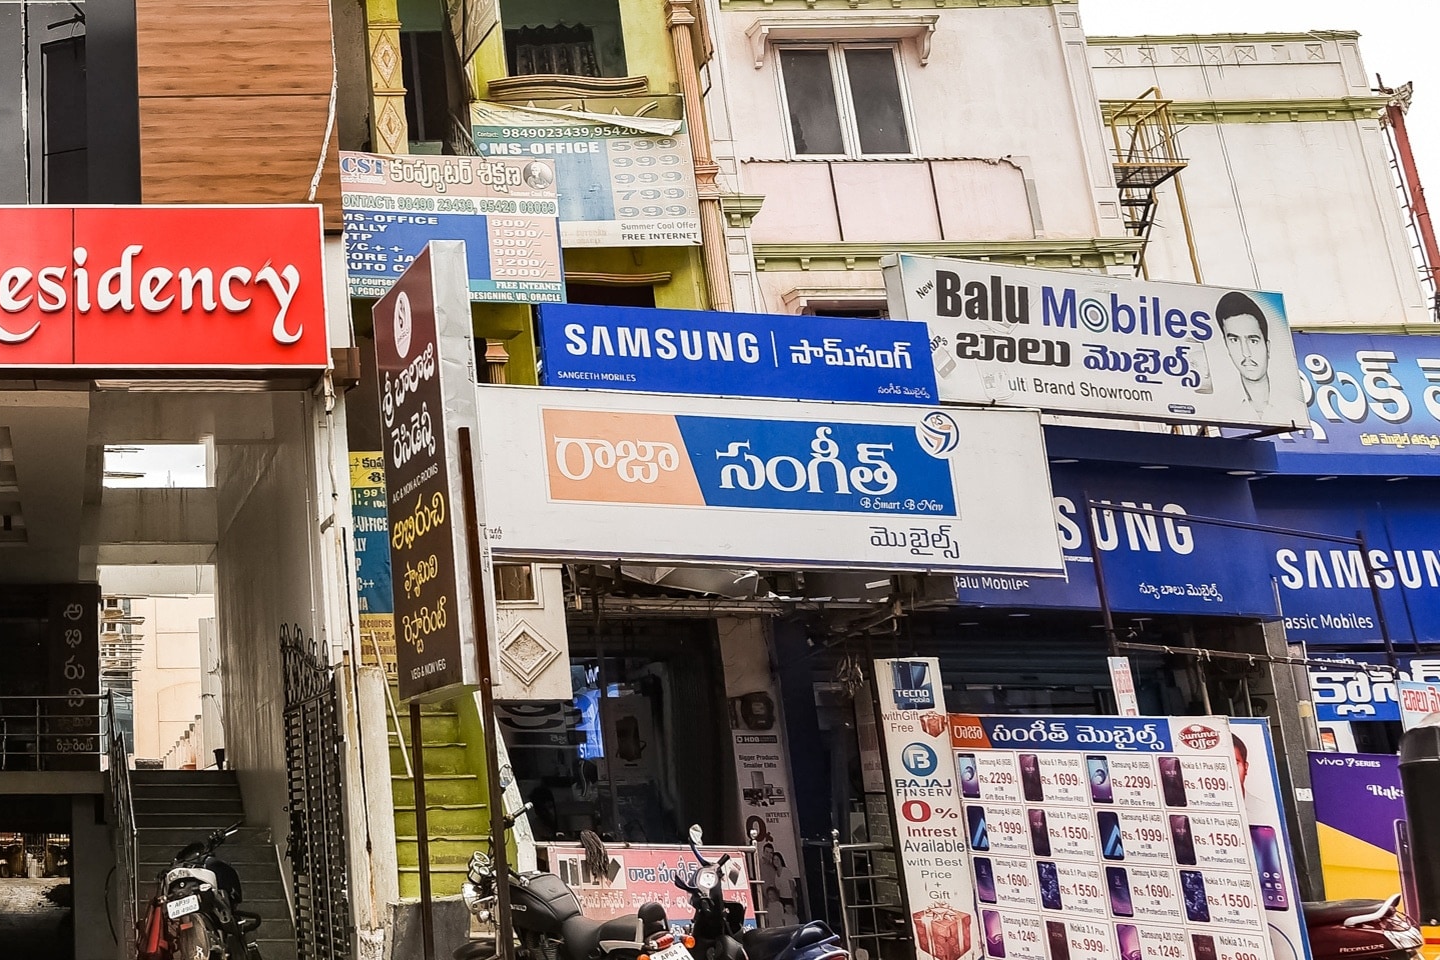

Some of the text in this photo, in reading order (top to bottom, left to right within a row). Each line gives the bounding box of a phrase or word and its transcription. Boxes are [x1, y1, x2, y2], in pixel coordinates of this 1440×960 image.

[490, 142, 599, 154] MS-OFFICE
[342, 157, 386, 175] CST
[389, 158, 473, 194] కంప్యూటర్
[397, 196, 557, 215] 98490 23439, 95420 08089
[677, 221, 697, 229] Offer
[493, 229, 552, 238] 1500/-
[494, 239, 541, 248] 900/-
[494, 249, 542, 257] 900/-
[496, 259, 554, 267] 1200/-
[496, 268, 555, 277] 2000/-
[520, 282, 562, 290] INTERNET
[530, 293, 561, 301] ORACLE
[915, 270, 1214, 341] New Balu Mobiles
[564, 323, 760, 364] SAMSUNG
[955, 332, 1071, 369] బాలు
[1082, 342, 1202, 388] మొబైల్స్
[557, 370, 637, 383] SANGEETH MOBILES
[1033, 378, 1154, 403] Brand Showroom
[553, 426, 899, 496] రాజా సంగీత్
[1054, 496, 1195, 555] SUNG
[869, 525, 961, 561] మొబైల్స్
[1160, 583, 1185, 597] బాలు
[1185, 582, 1224, 603] మొబైల్స్
[1320, 613, 1374, 630] Mobiles
[895, 689, 929, 697] TECNO
[891, 723, 914, 732] Free
[954, 719, 1166, 753] రాజా సంగీత్ మొబైల్స్
[1178, 731, 1221, 742] Summer
[1112, 761, 1131, 769] Samsung
[1316, 757, 1381, 768] vivo SERIES
[895, 779, 952, 787] BAJAJ
[906, 826, 958, 838] Intrest
[904, 840, 965, 854] Available
[906, 858, 962, 867] with Best
[921, 870, 952, 879] Price
[929, 890, 950, 900] Gift
[1219, 936, 1237, 946] Nokia
